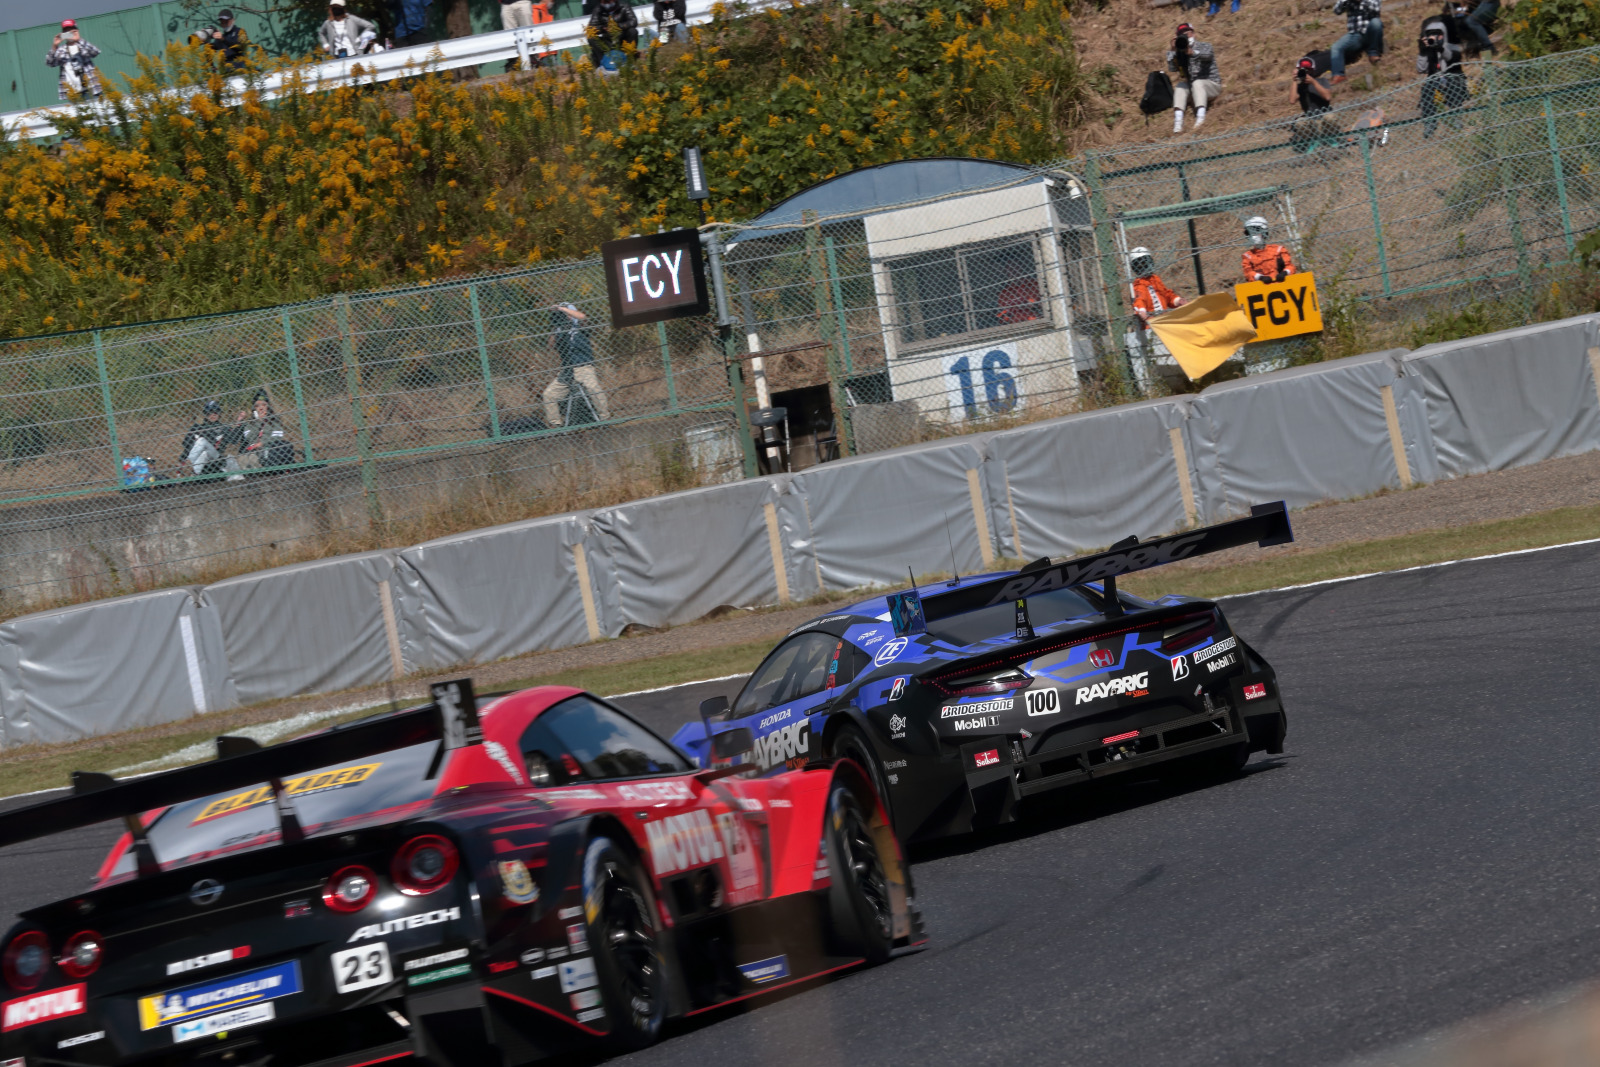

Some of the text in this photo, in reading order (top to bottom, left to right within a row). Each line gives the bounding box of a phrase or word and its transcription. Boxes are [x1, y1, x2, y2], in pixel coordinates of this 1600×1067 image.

[622, 250, 682, 302] FCY
[1247, 286, 1307, 329] FCY
[950, 350, 1018, 418] 16
[993, 533, 1207, 604] RAYBRIG
[876, 641, 908, 661] ZF
[1193, 636, 1236, 664] BRIDGESTONE
[1206, 656, 1230, 673] Mobil
[1027, 690, 1057, 714] 100
[1075, 671, 1149, 706] RAYBRIG
[758, 708, 792, 730] HONDA
[941, 698, 1014, 718] BRIDGESTONE
[954, 717, 986, 731] Mobil
[644, 808, 725, 875] MOTUL
[346, 906, 461, 943] AUTECH
[343, 951, 382, 985] 23
[3, 988, 84, 1028] MOTUL
[187, 975, 283, 1008] MICHELIN
